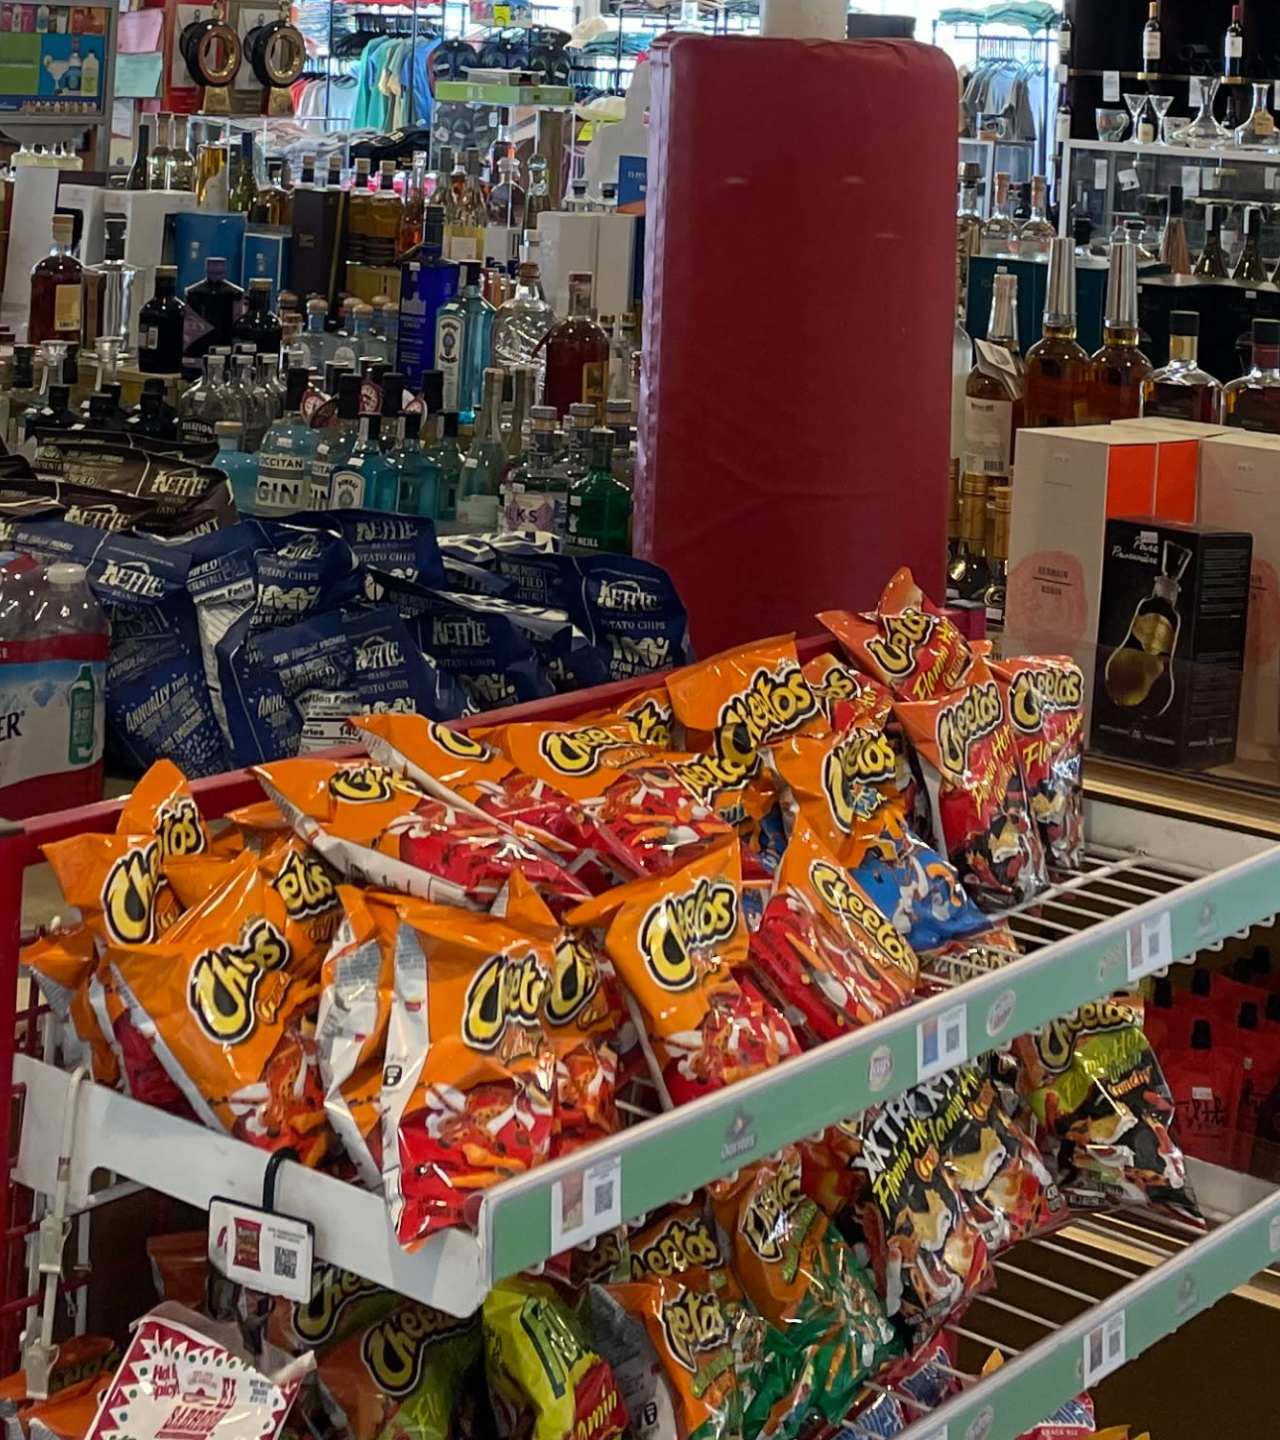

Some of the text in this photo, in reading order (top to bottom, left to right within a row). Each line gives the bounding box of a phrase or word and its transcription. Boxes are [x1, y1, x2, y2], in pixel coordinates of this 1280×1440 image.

[256, 480, 300, 503] GIN
[98, 560, 166, 599] KETTLE
[937, 682, 1003, 776] Cheetos
[1009, 667, 1084, 735] Cheetos
[639, 880, 738, 990] Cheetos
